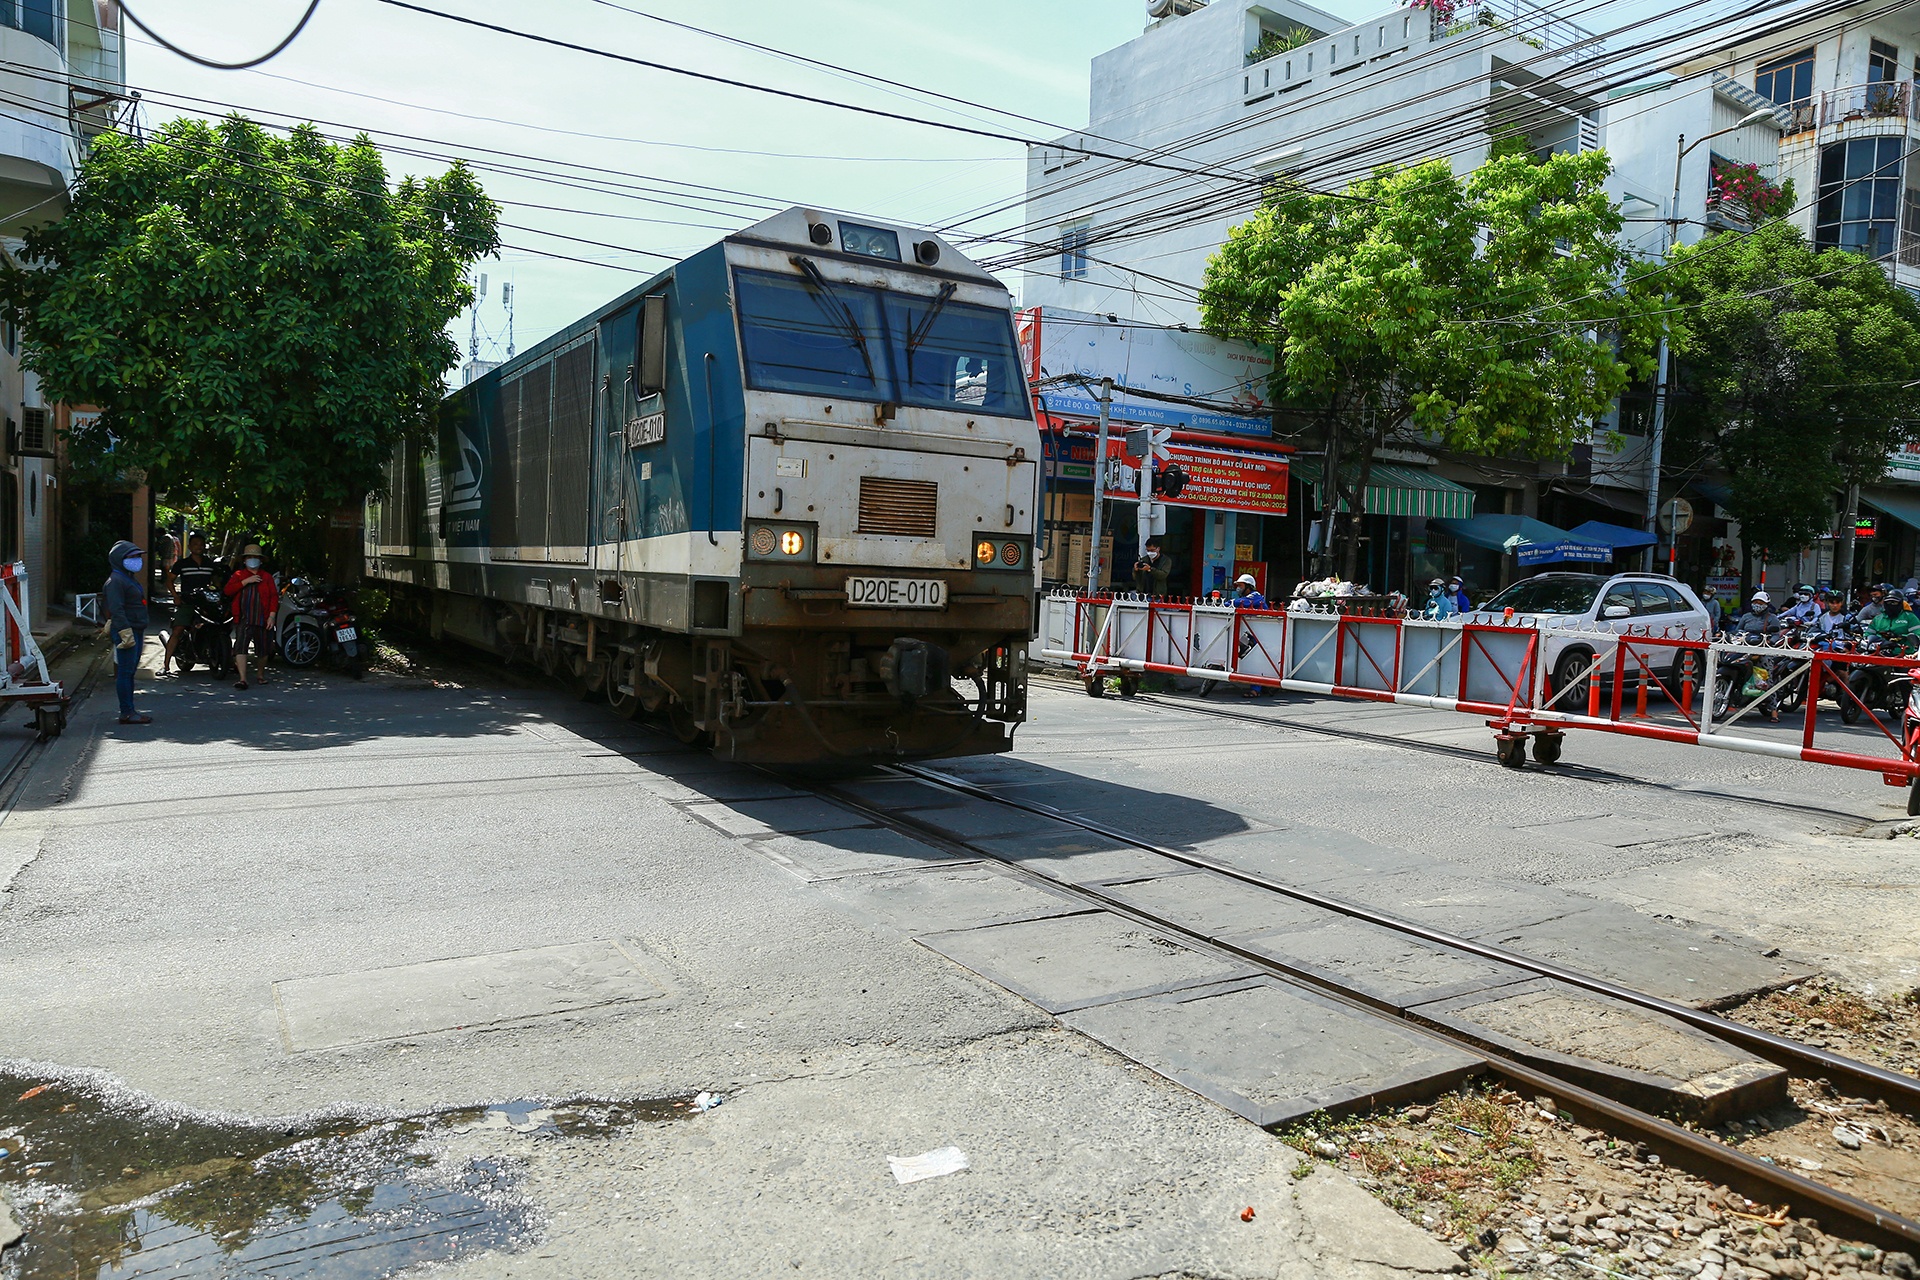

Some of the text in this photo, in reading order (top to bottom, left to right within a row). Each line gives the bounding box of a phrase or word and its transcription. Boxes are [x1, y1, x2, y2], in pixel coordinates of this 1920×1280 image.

[1063, 400, 1071, 408] LÊ
[1093, 403, 1112, 413] THH
[1195, 456, 1211, 465] TRÌNH
[1222, 459, 1234, 467] MÁY
[1203, 486, 1218, 494] TRÊN
[1231, 480, 1244, 488] MÁY
[1188, 493, 1226, 503] 04/04/2022
[1251, 500, 1287, 508] 04/06/2022
[465, 519, 480, 532] NAM
[852, 579, 940, 604] D20E-010
